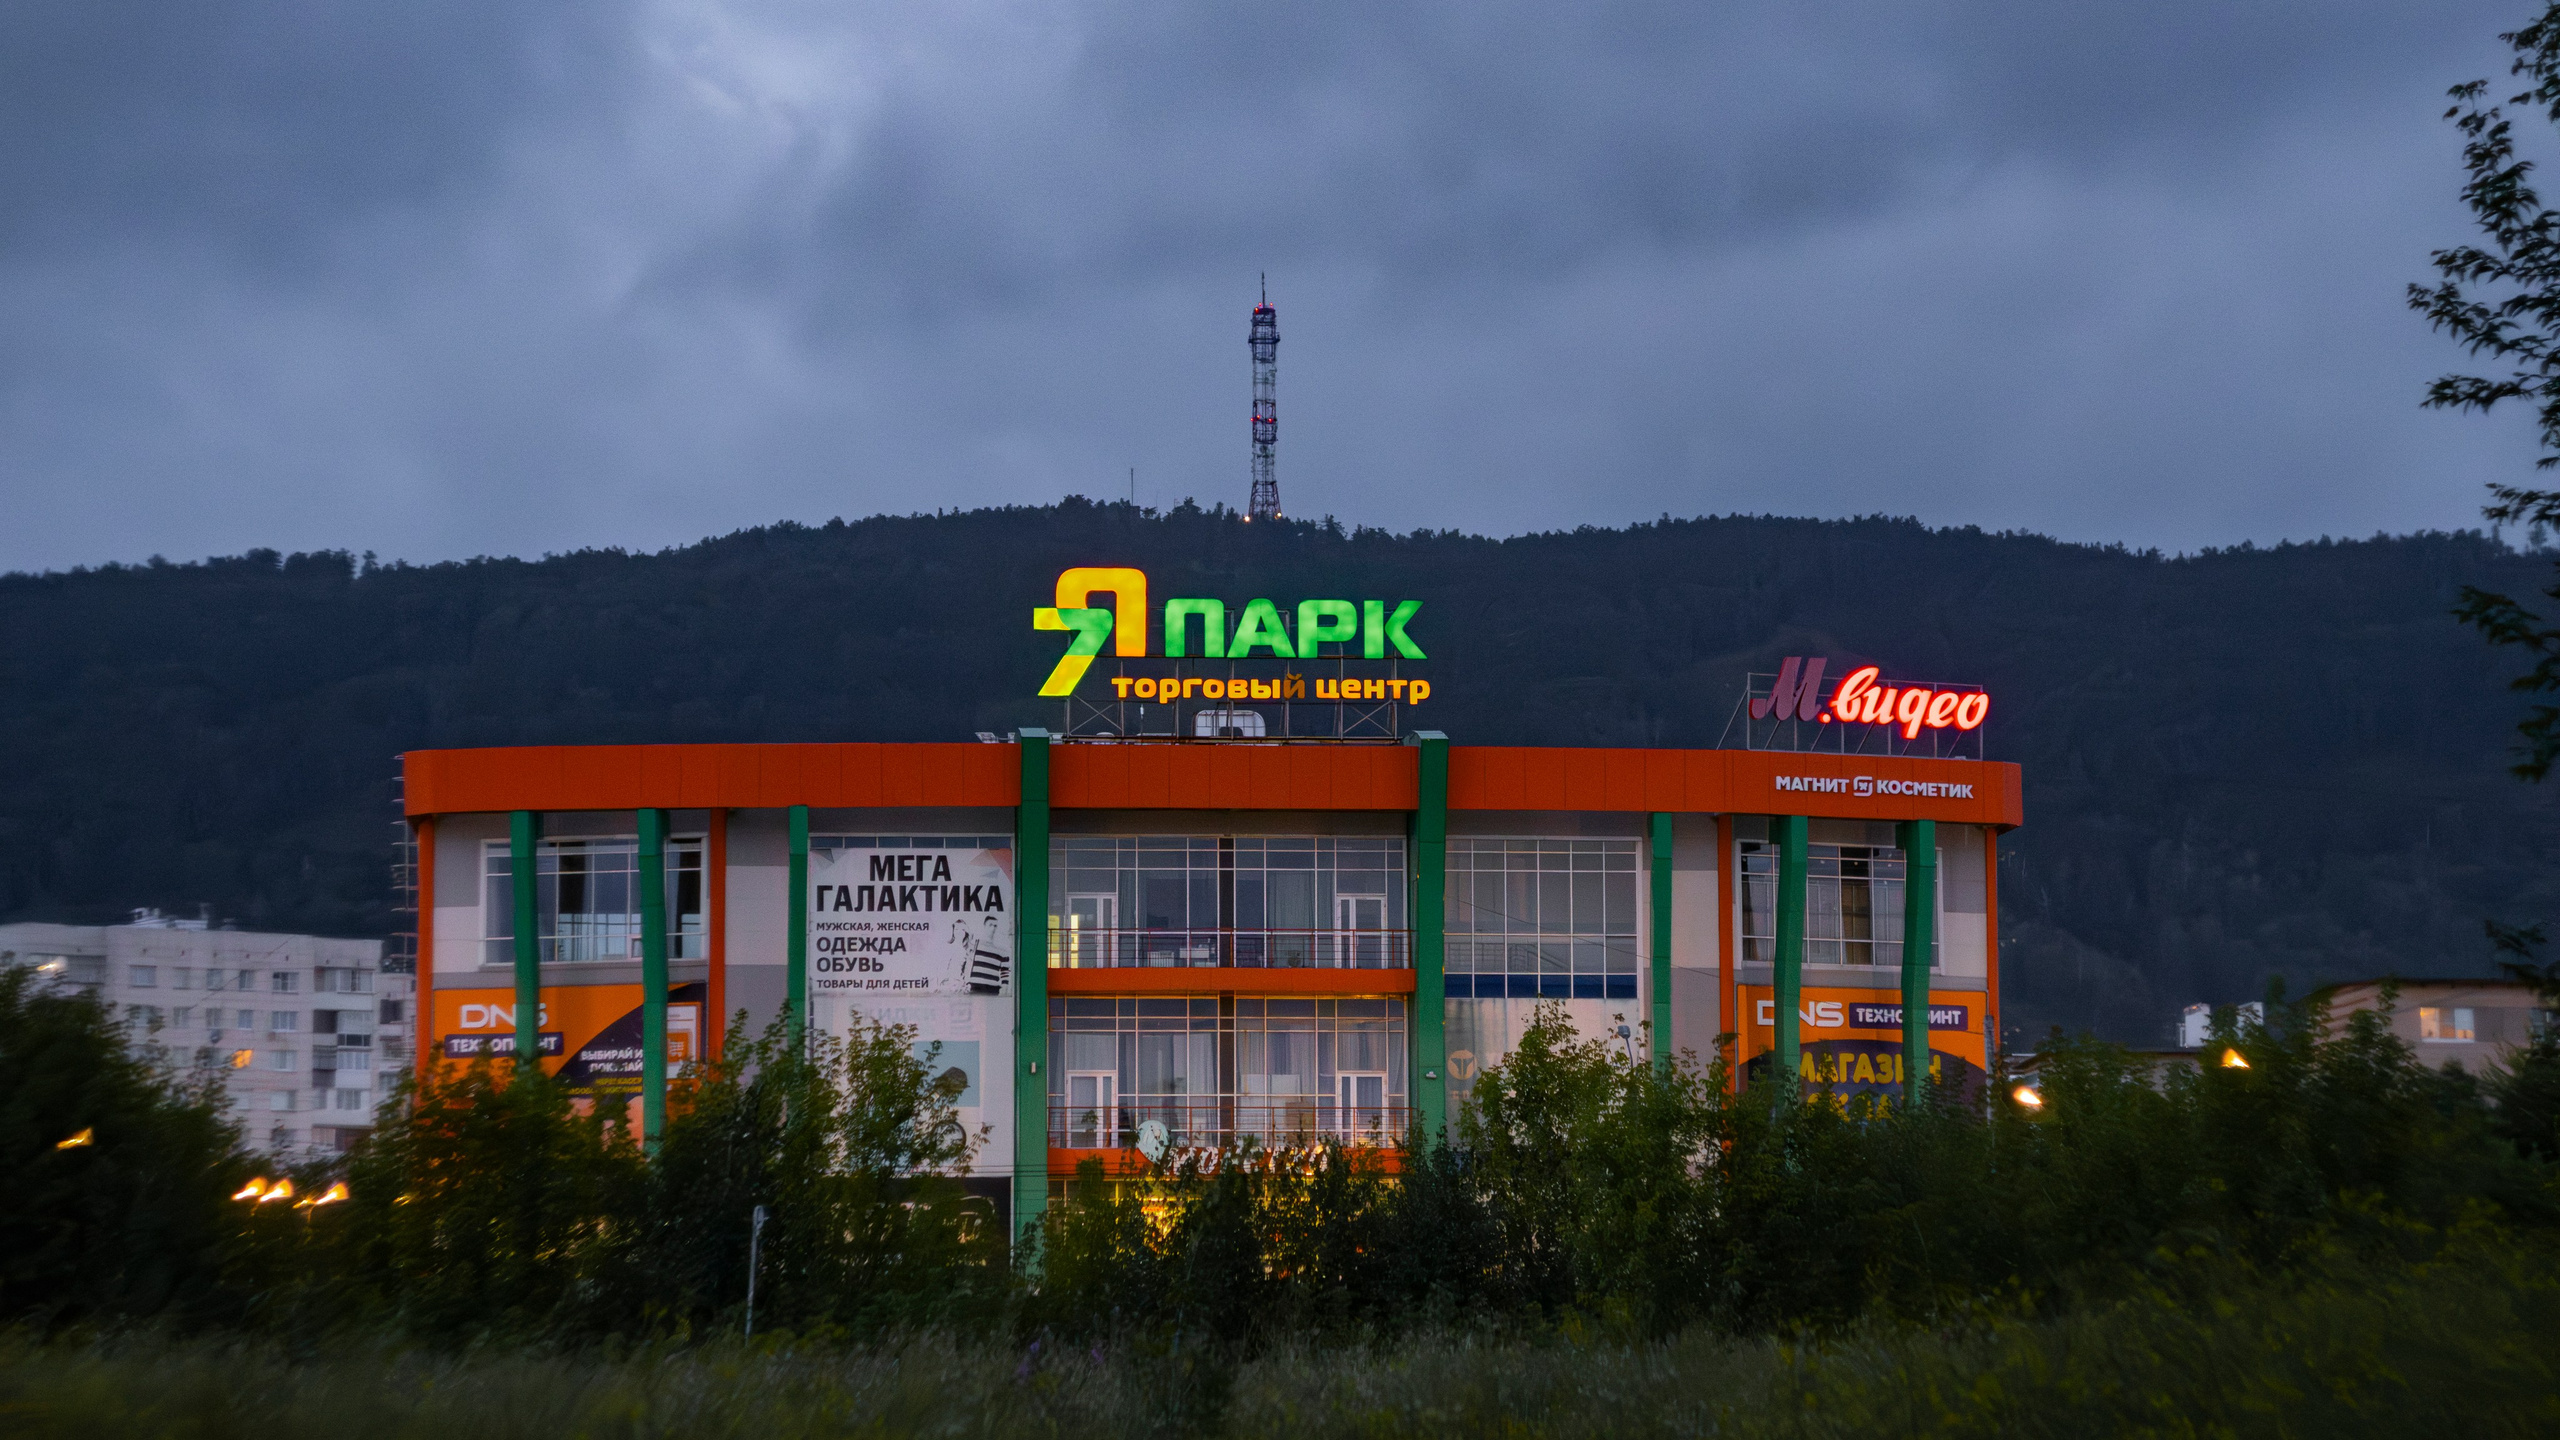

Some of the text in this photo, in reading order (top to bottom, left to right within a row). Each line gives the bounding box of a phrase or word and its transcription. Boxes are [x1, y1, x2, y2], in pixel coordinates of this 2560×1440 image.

[1165, 598, 1427, 659] ПАРК
[1112, 673, 1430, 705] торговый центр
[1775, 776, 1974, 799] МАГНИТ КОСМЕТИК
[869, 854, 952, 882] МЕГА
[816, 884, 1005, 913] ГАЛАКТИКА
[816, 922, 930, 932] МУЖСКАЯ, ЖЕНСКАЯ
[816, 936, 907, 955] ОДЕЖДА
[816, 957, 884, 973] ОБУВЬ
[817, 976, 929, 990] ТОВАРЫ ДЛЯ ДЕТЕЙ
[1857, 1007, 1962, 1025] ТЕХНОИНТ
